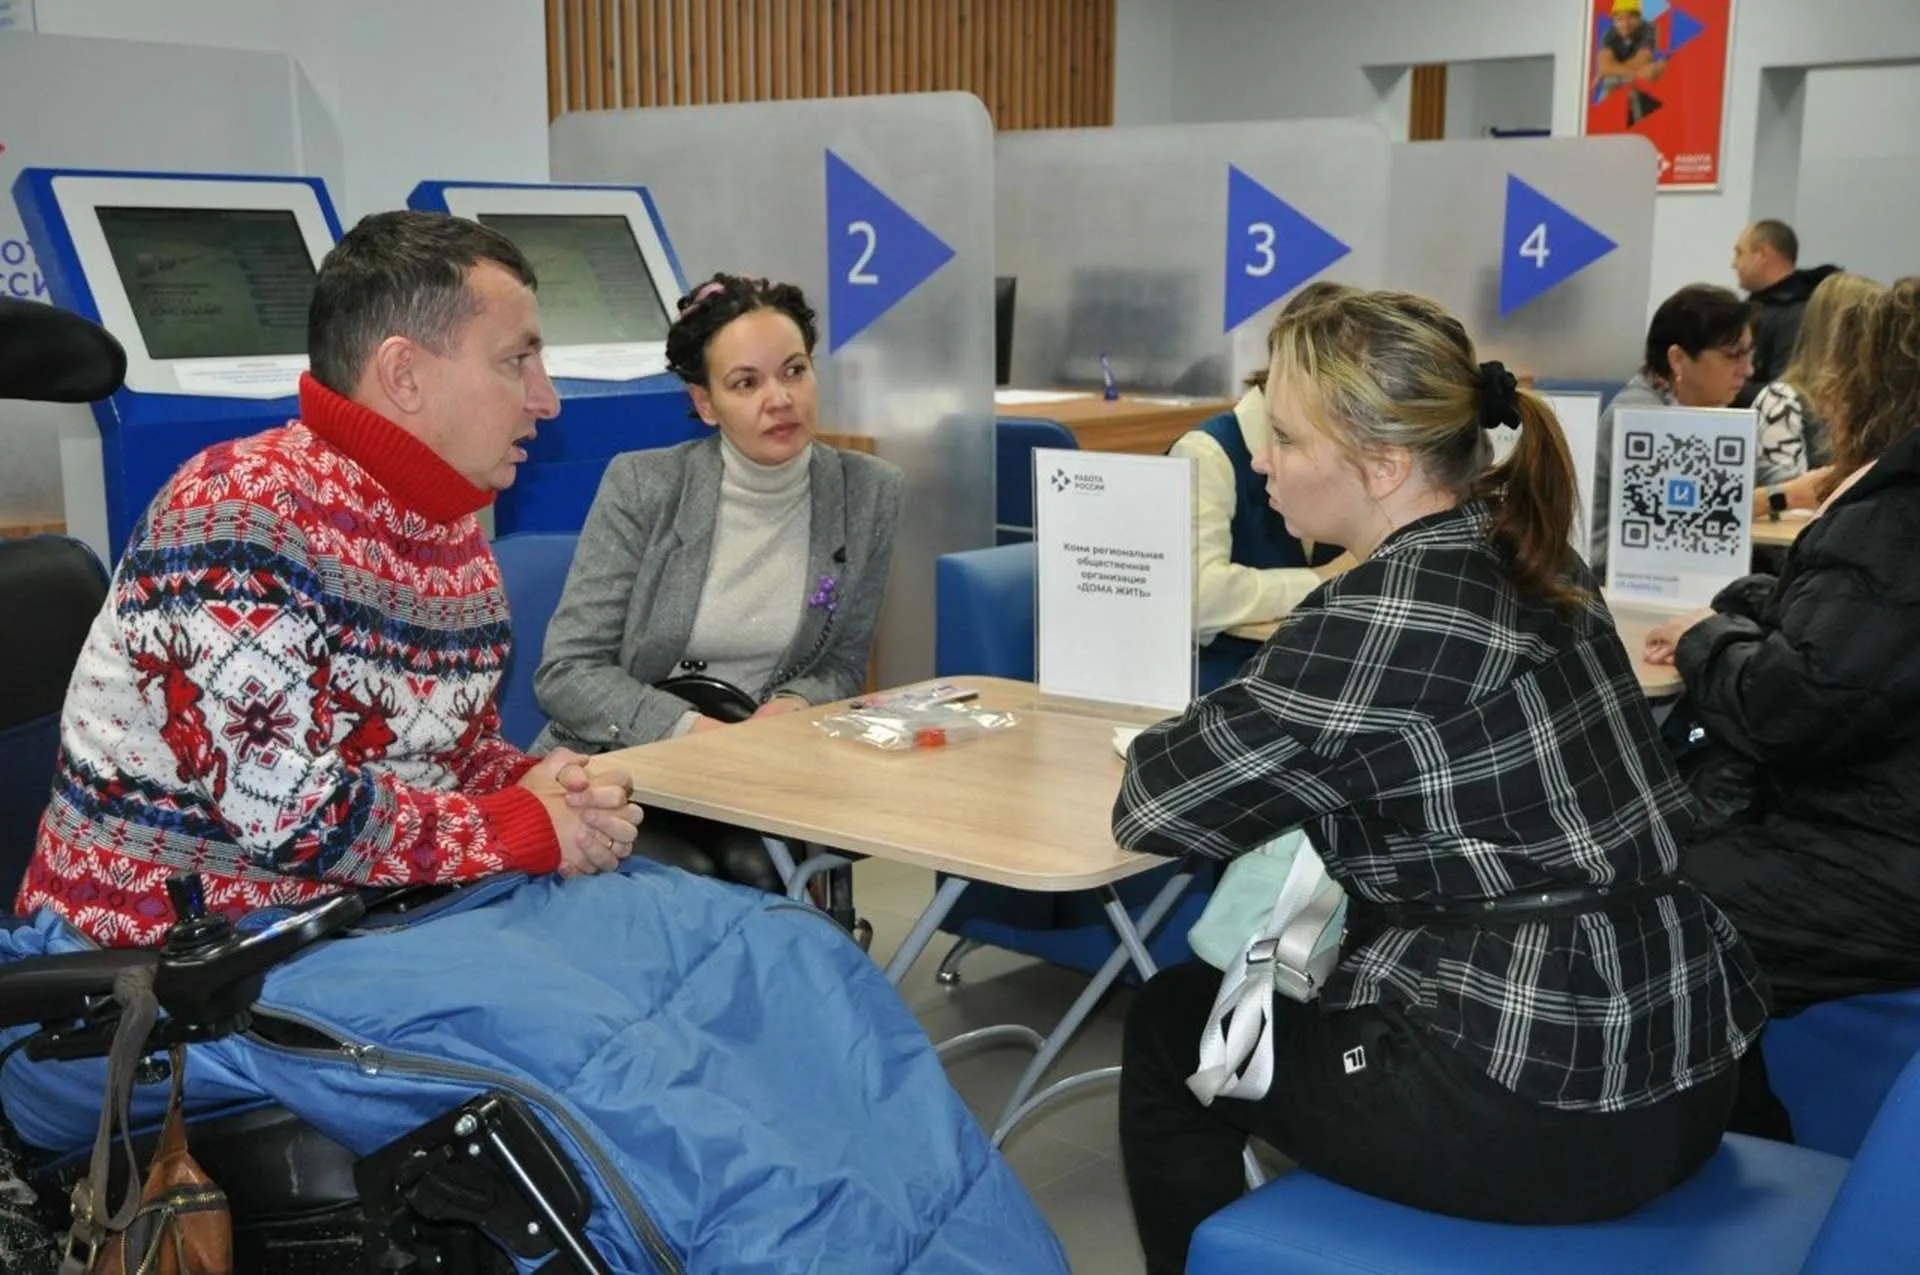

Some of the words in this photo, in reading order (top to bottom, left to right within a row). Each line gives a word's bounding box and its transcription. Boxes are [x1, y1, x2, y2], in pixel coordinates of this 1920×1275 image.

[848, 221, 878, 284] 2
[1246, 223, 1275, 276] 3
[1519, 223, 1549, 268] 4
[1063, 543, 1089, 552] Коми
[1092, 546, 1164, 559] региональная
[1076, 557, 1150, 571] общественная
[1081, 571, 1146, 584] организация
